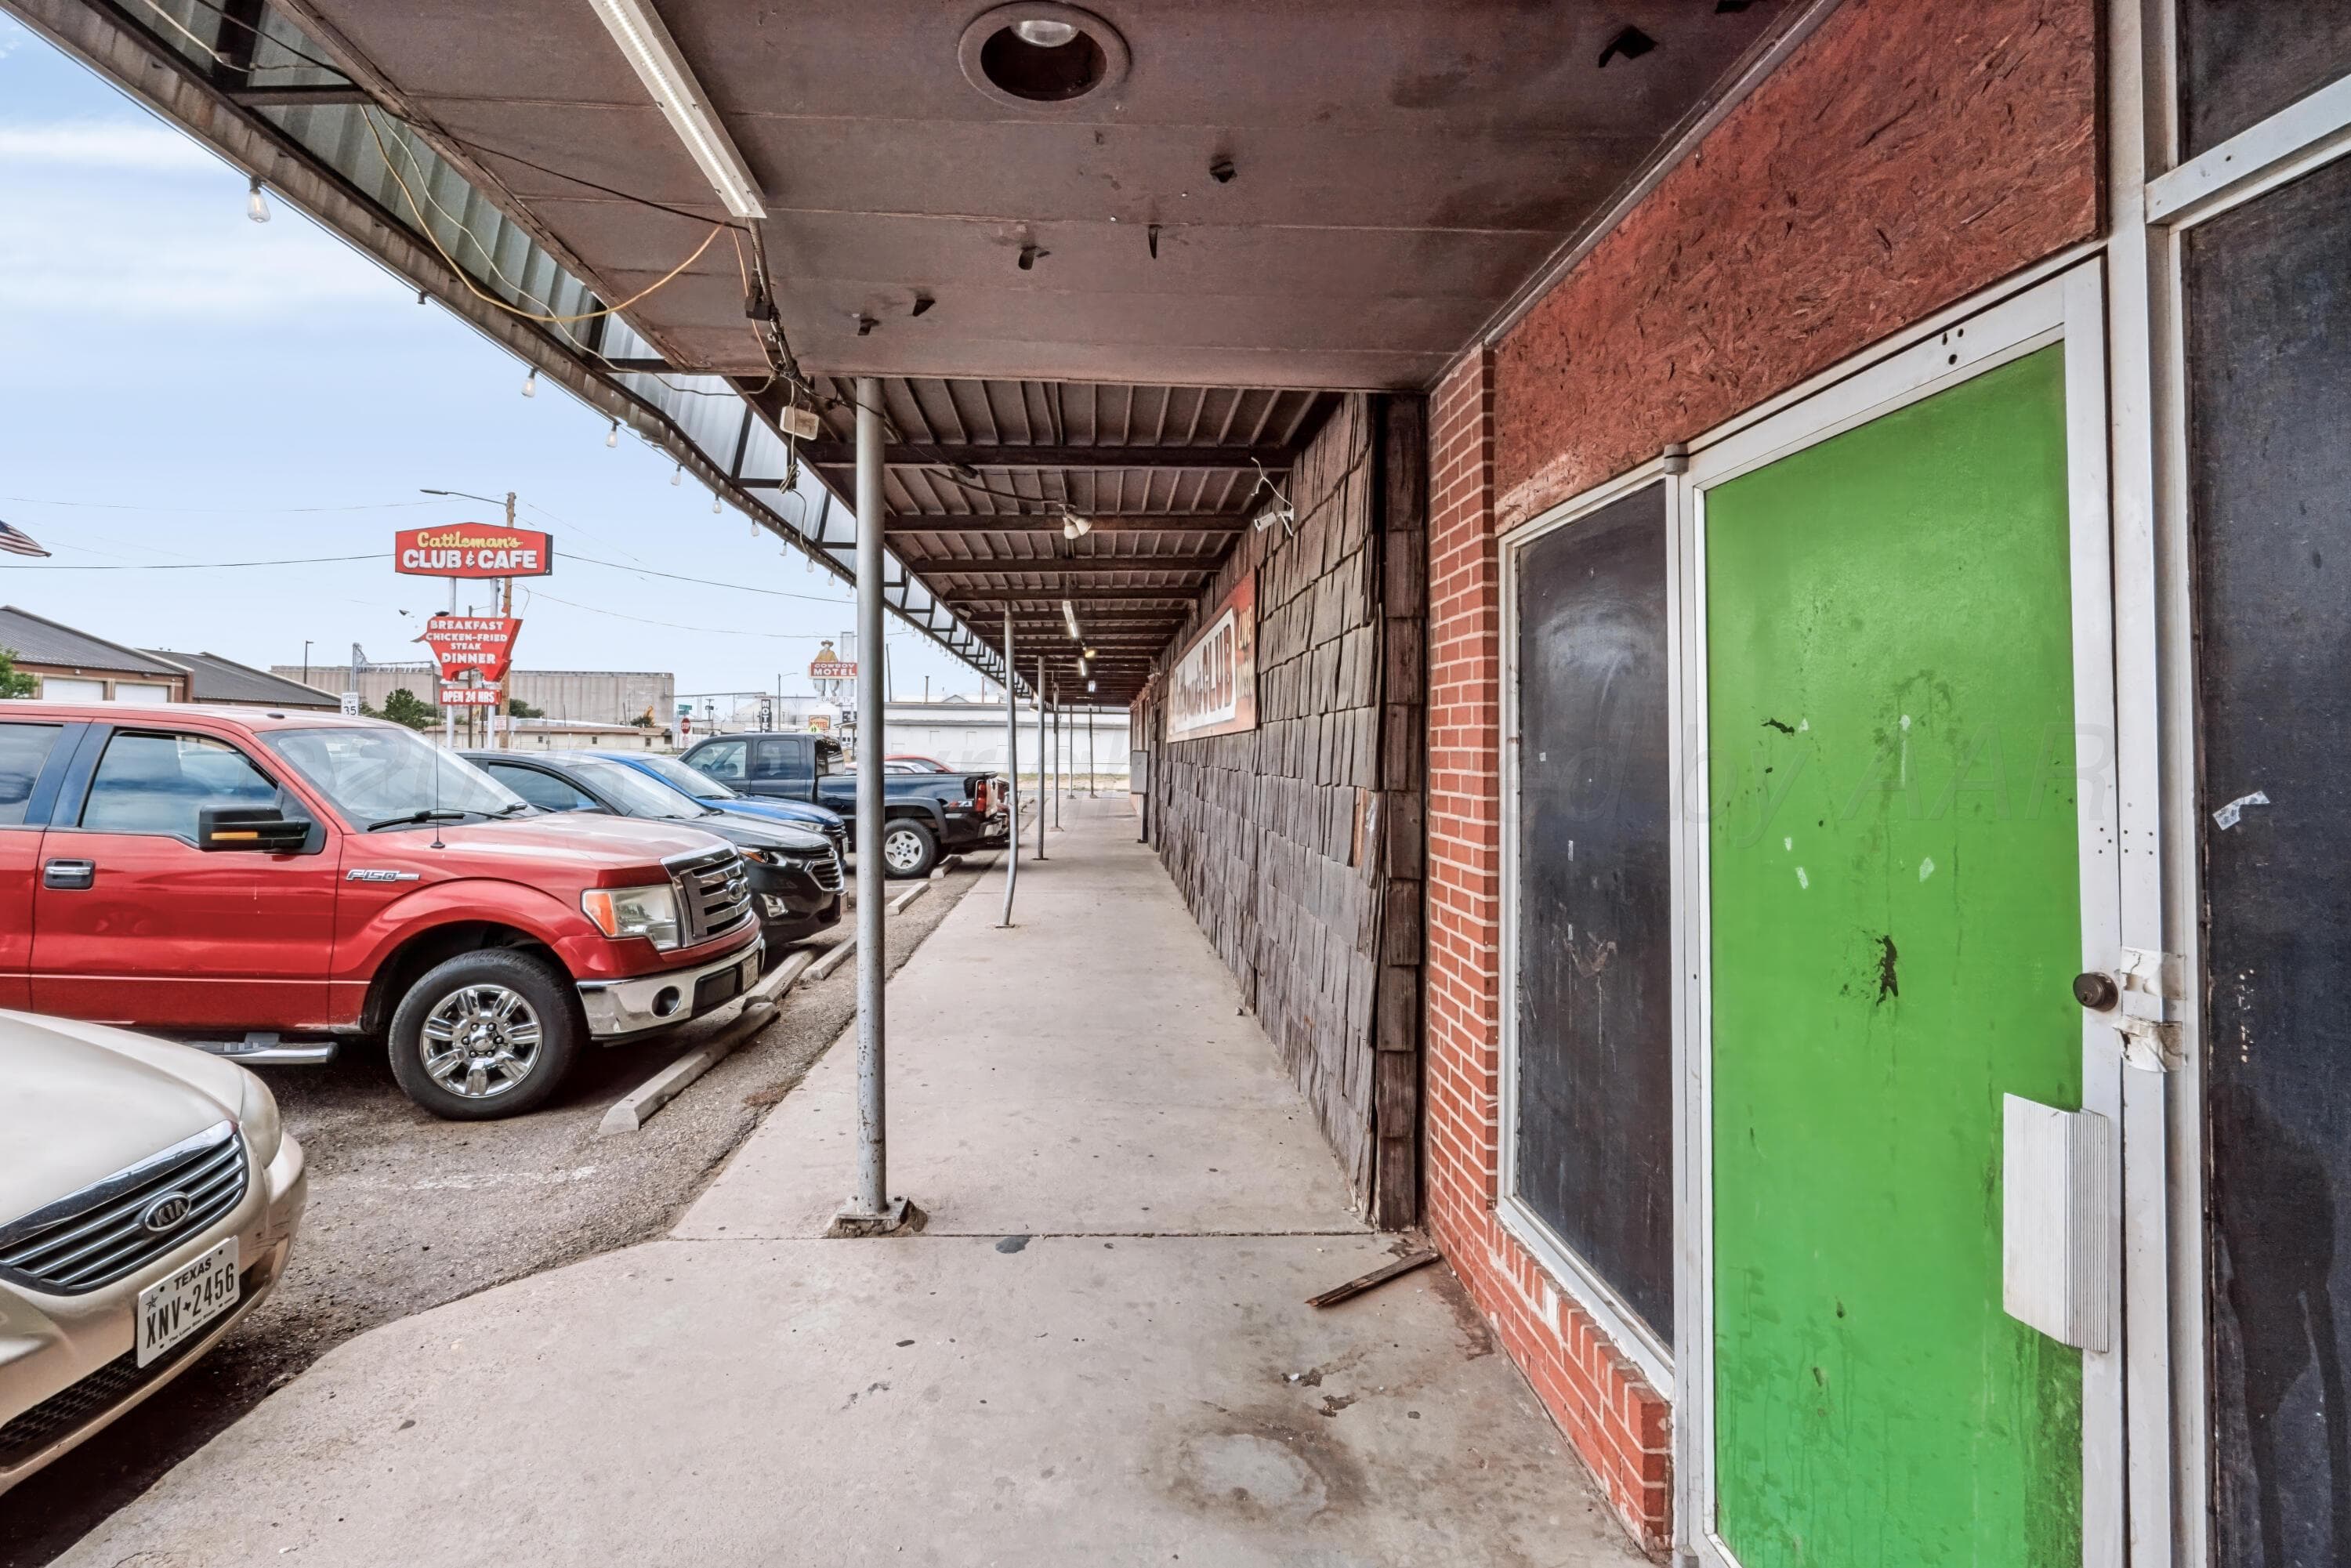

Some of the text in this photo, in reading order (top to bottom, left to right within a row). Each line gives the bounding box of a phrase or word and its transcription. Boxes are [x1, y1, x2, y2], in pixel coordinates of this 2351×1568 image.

[417, 531, 523, 548] Cattleman's
[403, 549, 538, 569] CLUB & CAFE
[430, 620, 504, 630] BREAKFAST
[1238, 604, 1252, 650] LIVE
[426, 632, 508, 642] CHICKEN-FRIED
[441, 652, 496, 664] DINNER
[1203, 624, 1233, 715] CLUB
[442, 690, 495, 703] OPEN 24 HRS
[343, 706, 357, 715] 35
[154, 1200, 187, 1226] KIA
[174, 1257, 212, 1291] TEXAS
